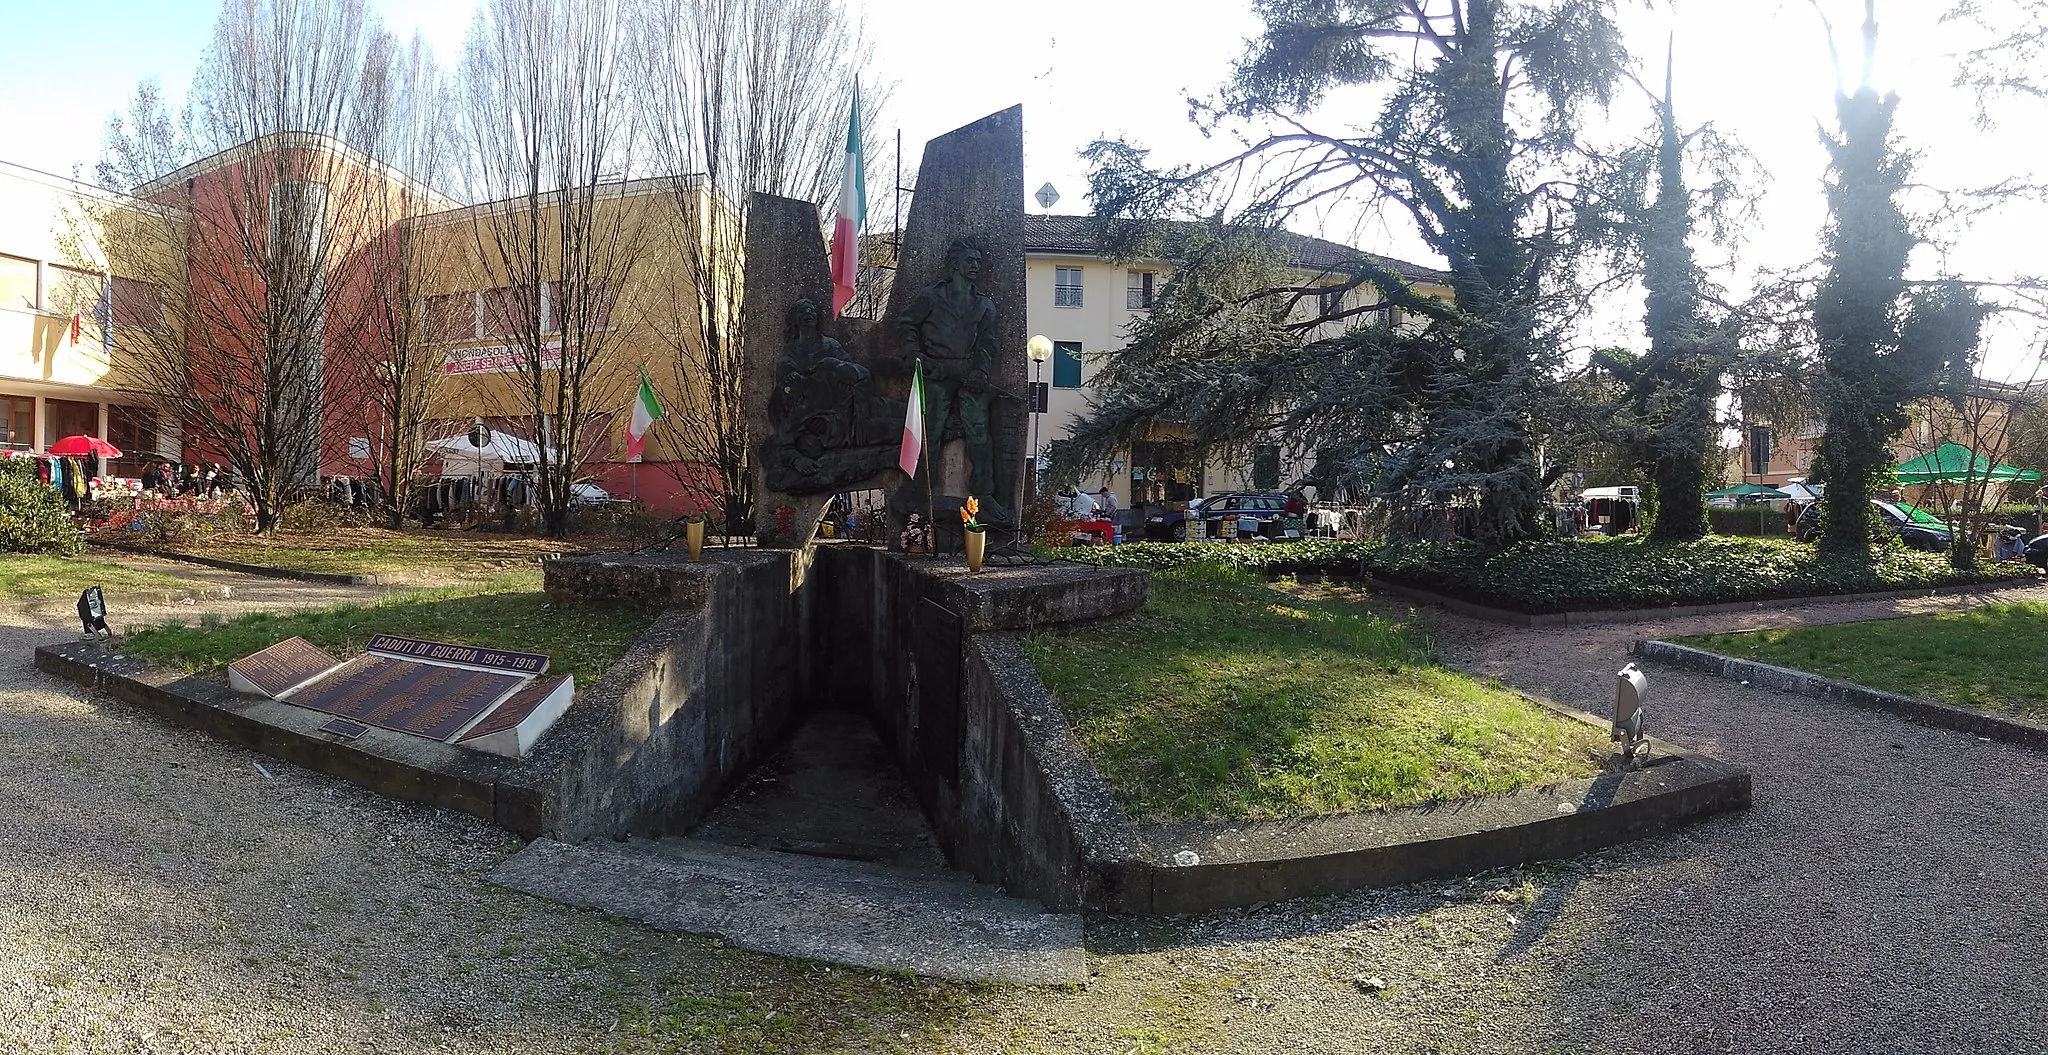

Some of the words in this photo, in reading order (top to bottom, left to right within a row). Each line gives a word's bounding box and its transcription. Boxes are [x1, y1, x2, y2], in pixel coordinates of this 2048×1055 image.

[374, 637, 415, 653] CADUTI
[416, 643, 431, 655] DI
[431, 645, 479, 662] GUERRA
